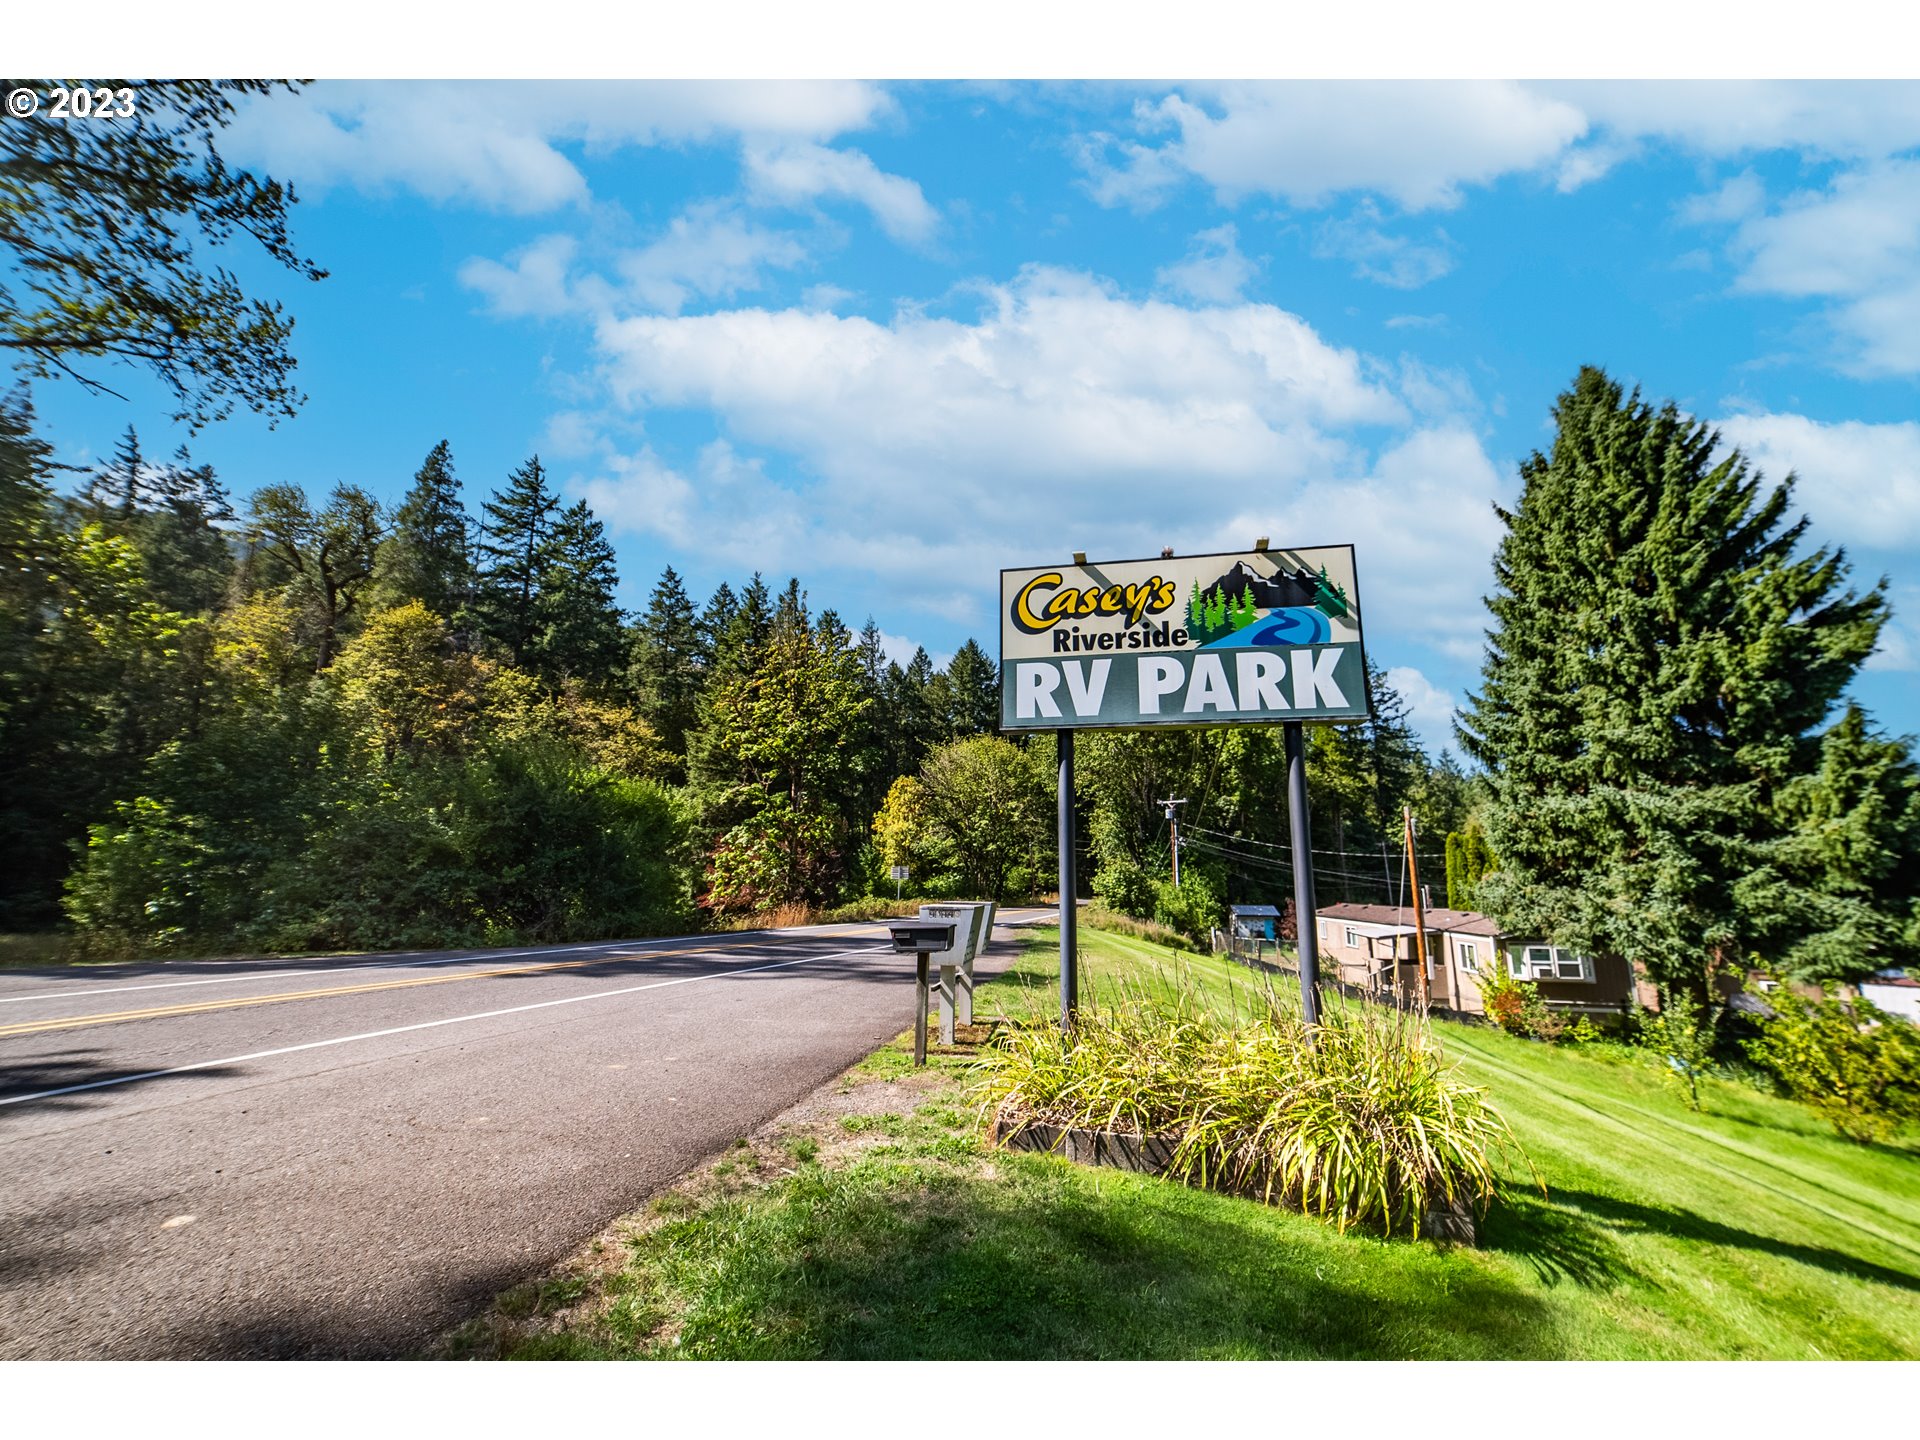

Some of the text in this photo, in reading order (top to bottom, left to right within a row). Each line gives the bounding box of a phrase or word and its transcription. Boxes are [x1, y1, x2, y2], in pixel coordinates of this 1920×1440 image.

[1011, 572, 1176, 635] Casey's
[1053, 620, 1189, 653] Riverside
[1016, 647, 1351, 719] RV PARK
